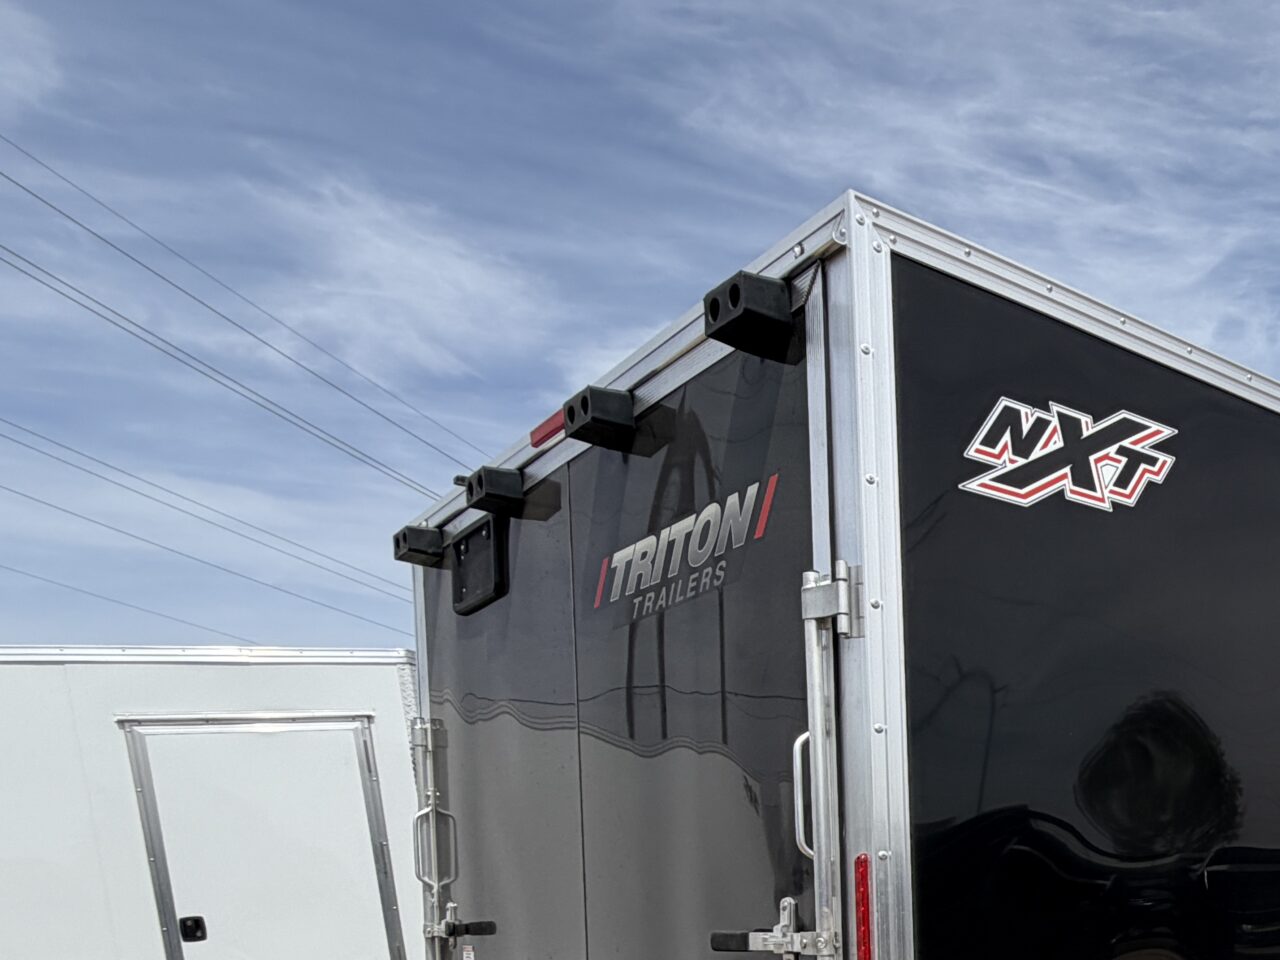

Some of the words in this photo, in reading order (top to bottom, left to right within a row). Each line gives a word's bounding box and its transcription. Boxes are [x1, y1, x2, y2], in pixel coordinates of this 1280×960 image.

[958, 396, 1179, 512] NXT
[610, 482, 760, 602] TRITON
[632, 560, 727, 619] TRAILERS
